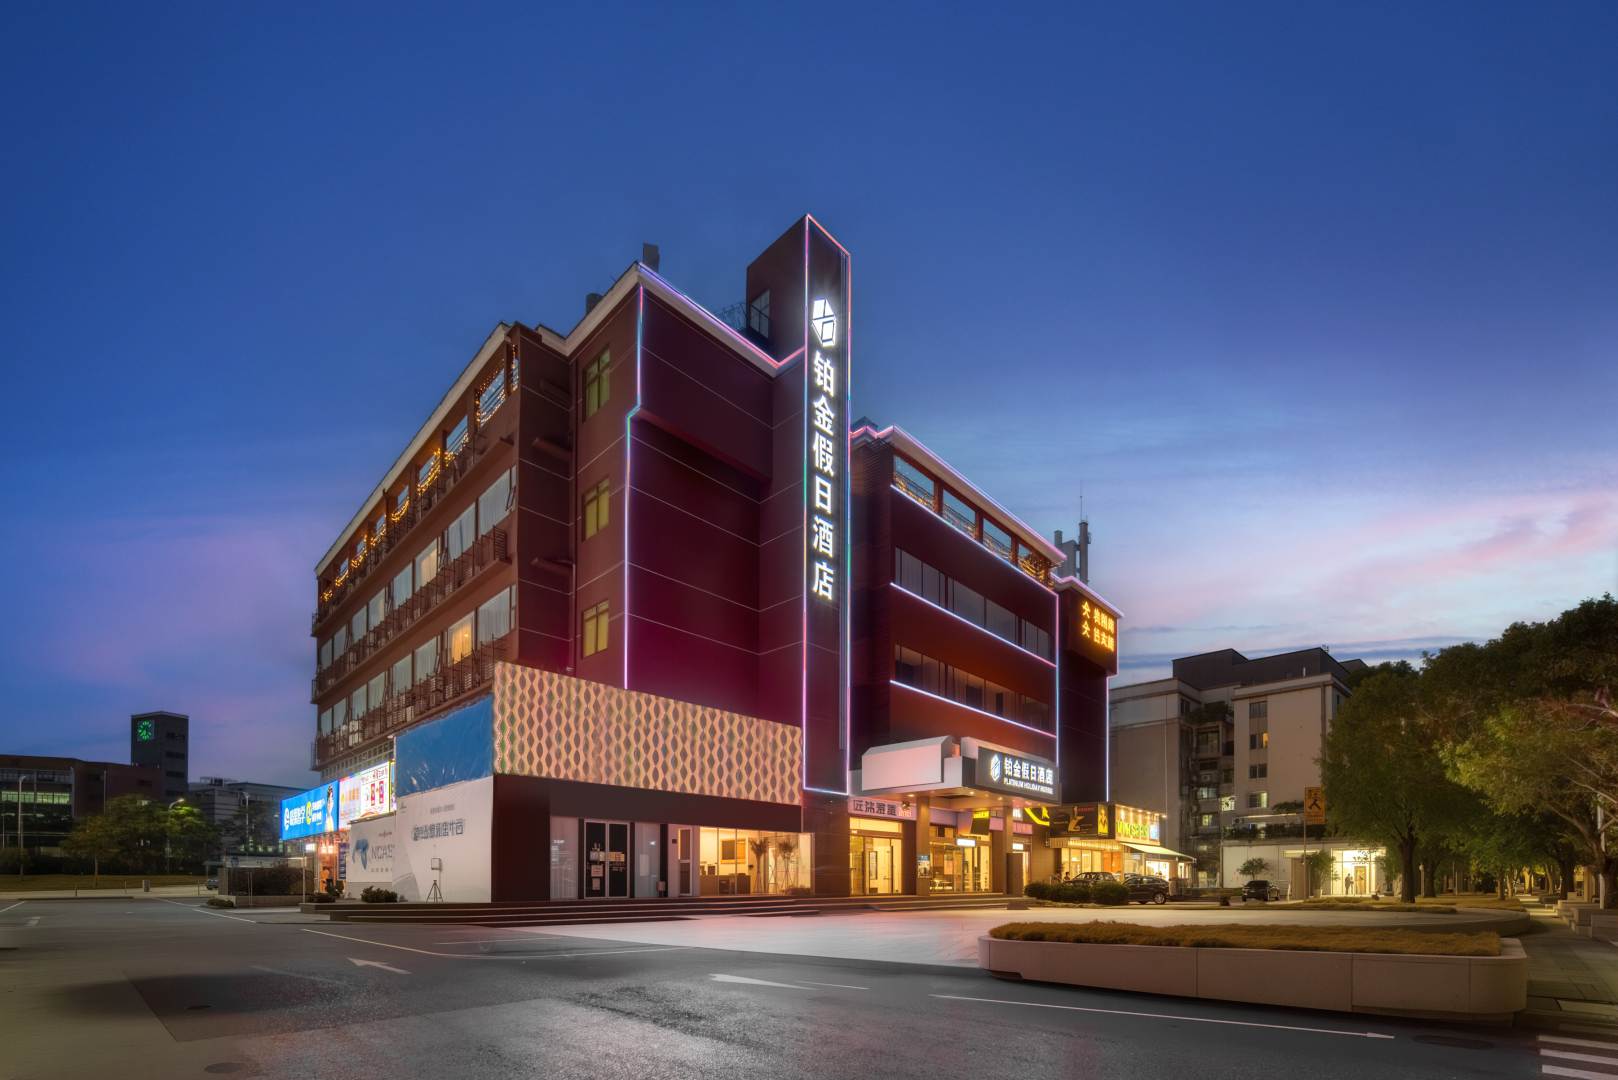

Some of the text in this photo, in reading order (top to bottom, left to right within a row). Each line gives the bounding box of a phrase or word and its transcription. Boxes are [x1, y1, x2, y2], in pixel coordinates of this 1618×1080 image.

[811, 350, 835, 600] 铂金假日酒店
[1004, 757, 1054, 785] 铂金假日酒店
